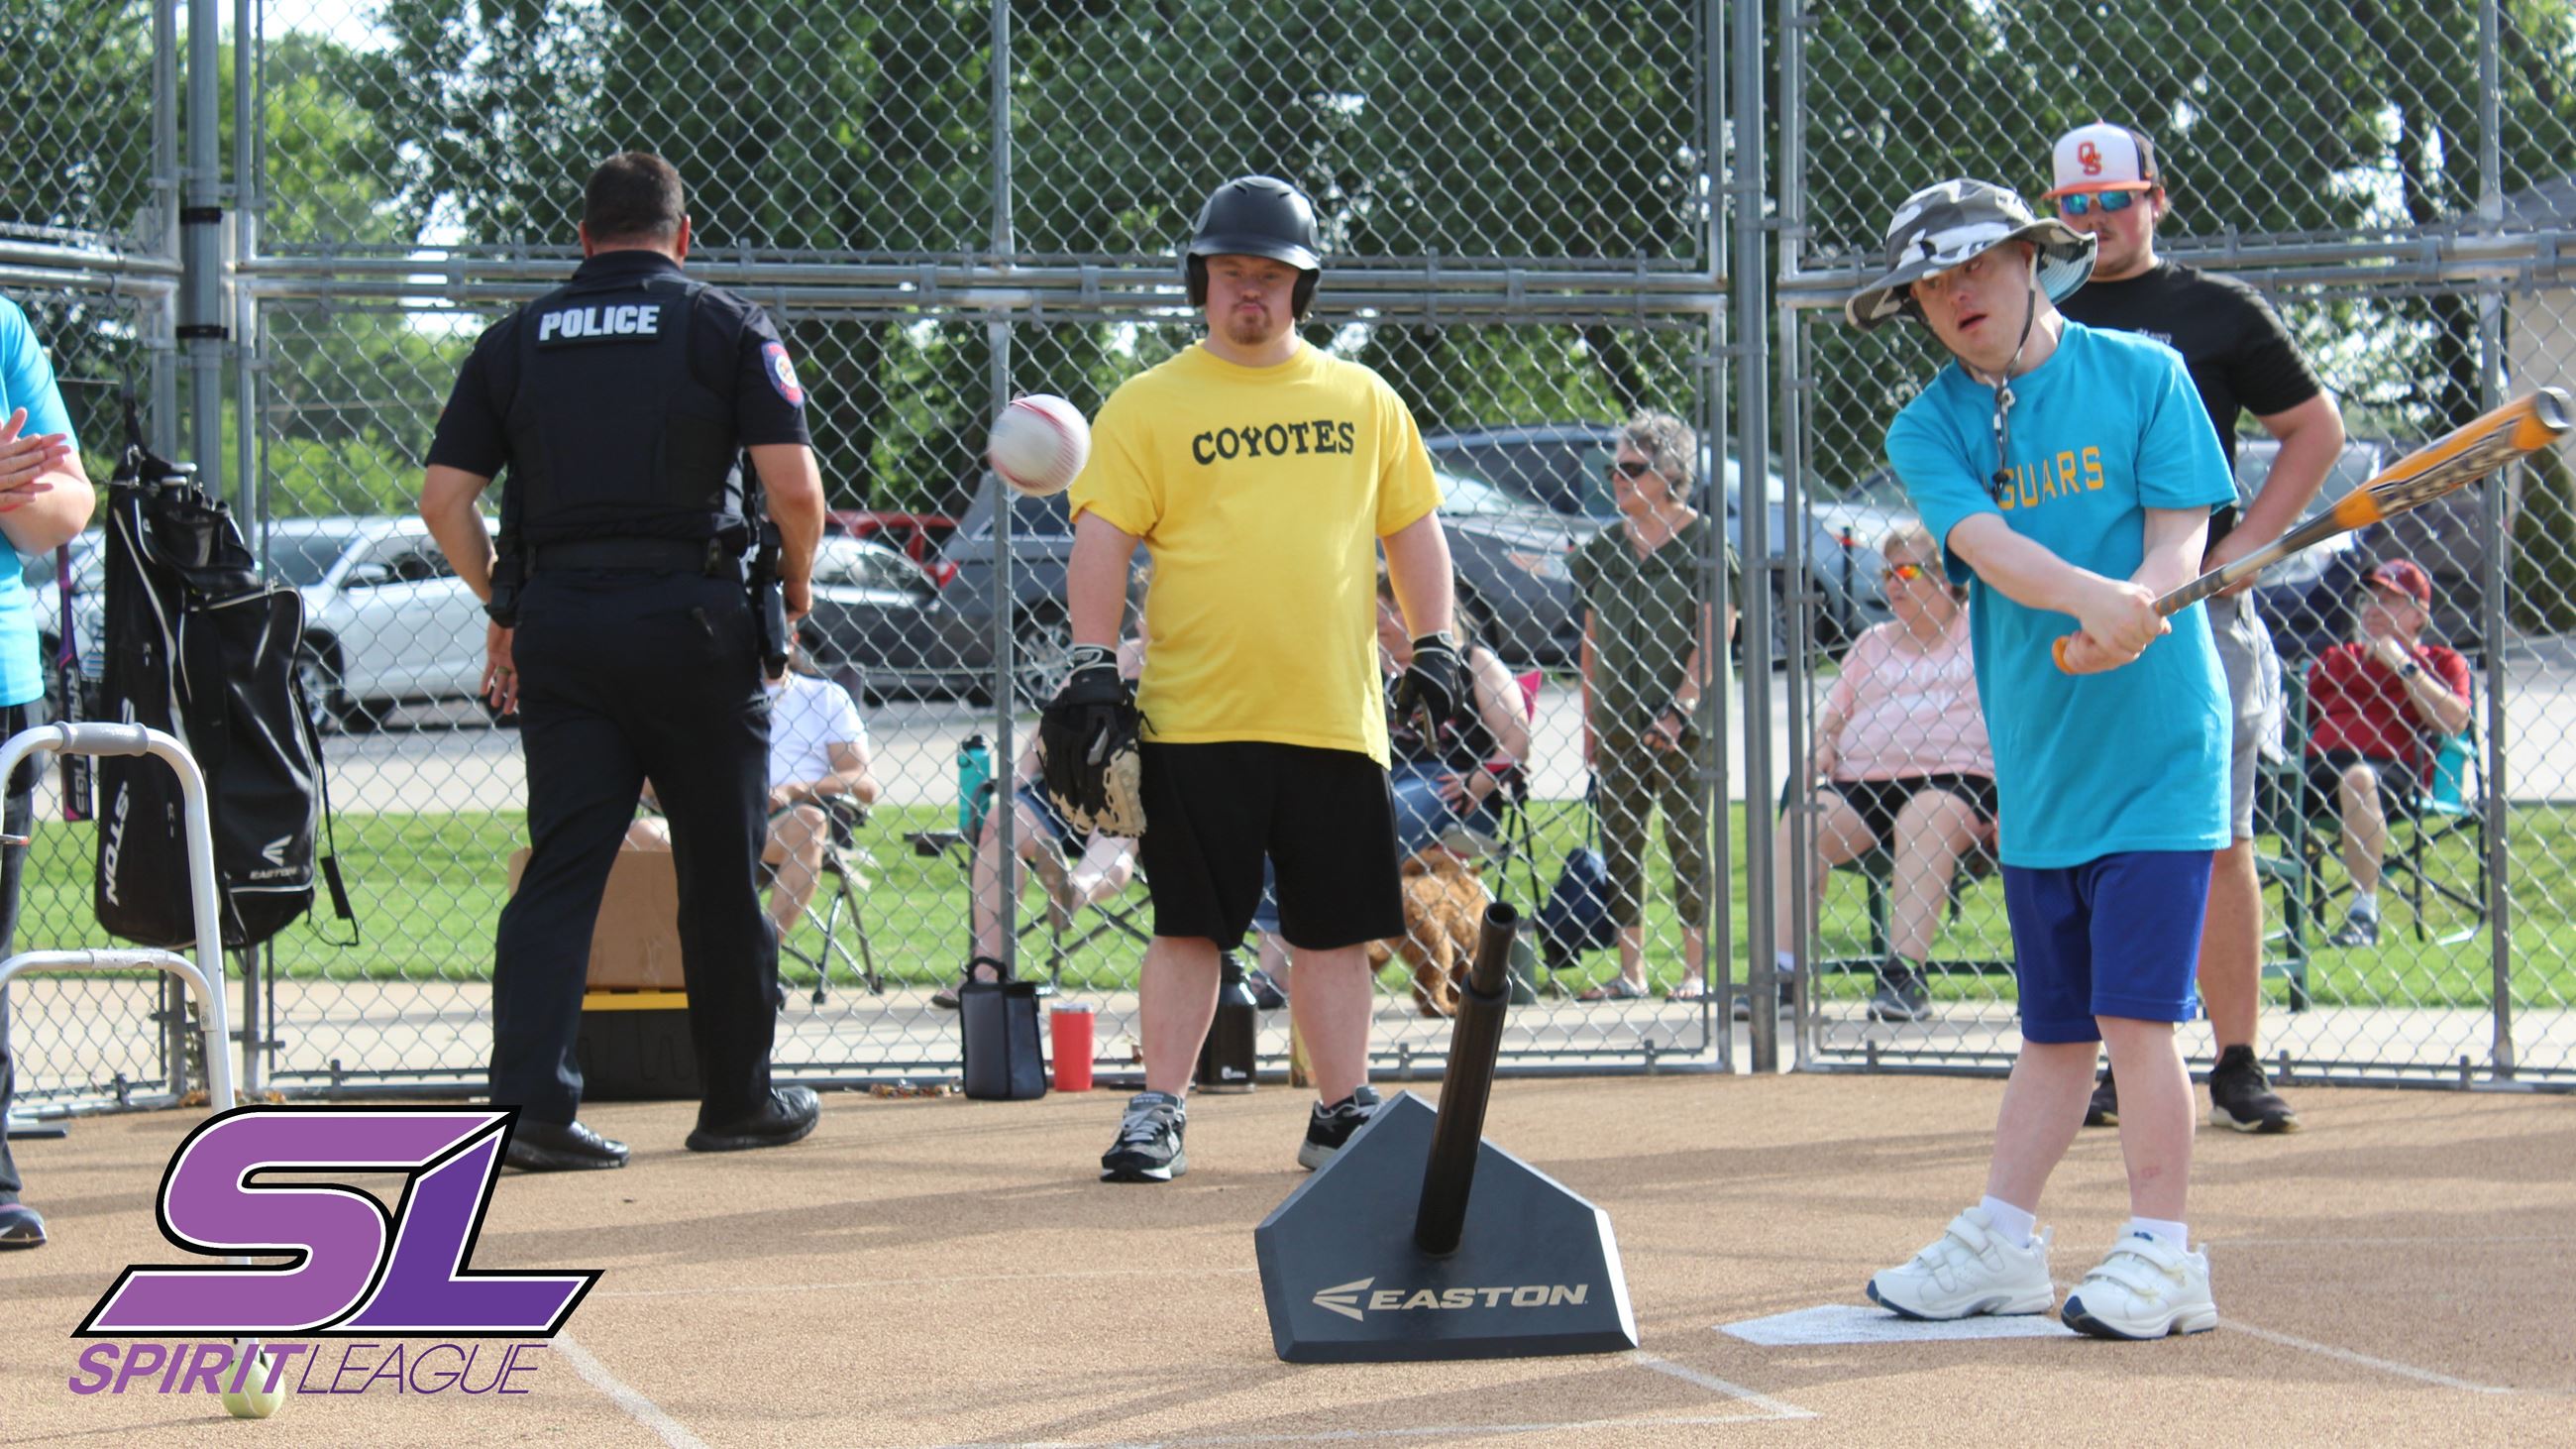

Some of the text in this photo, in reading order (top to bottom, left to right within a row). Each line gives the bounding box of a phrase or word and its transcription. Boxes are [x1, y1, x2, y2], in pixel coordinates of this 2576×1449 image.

[539, 305, 661, 342] POLICE
[1192, 419, 1355, 466] COYOTES
[1997, 445, 2104, 510] GUARS
[104, 781, 129, 907] STON
[1367, 1284, 1589, 1310] EASTON
